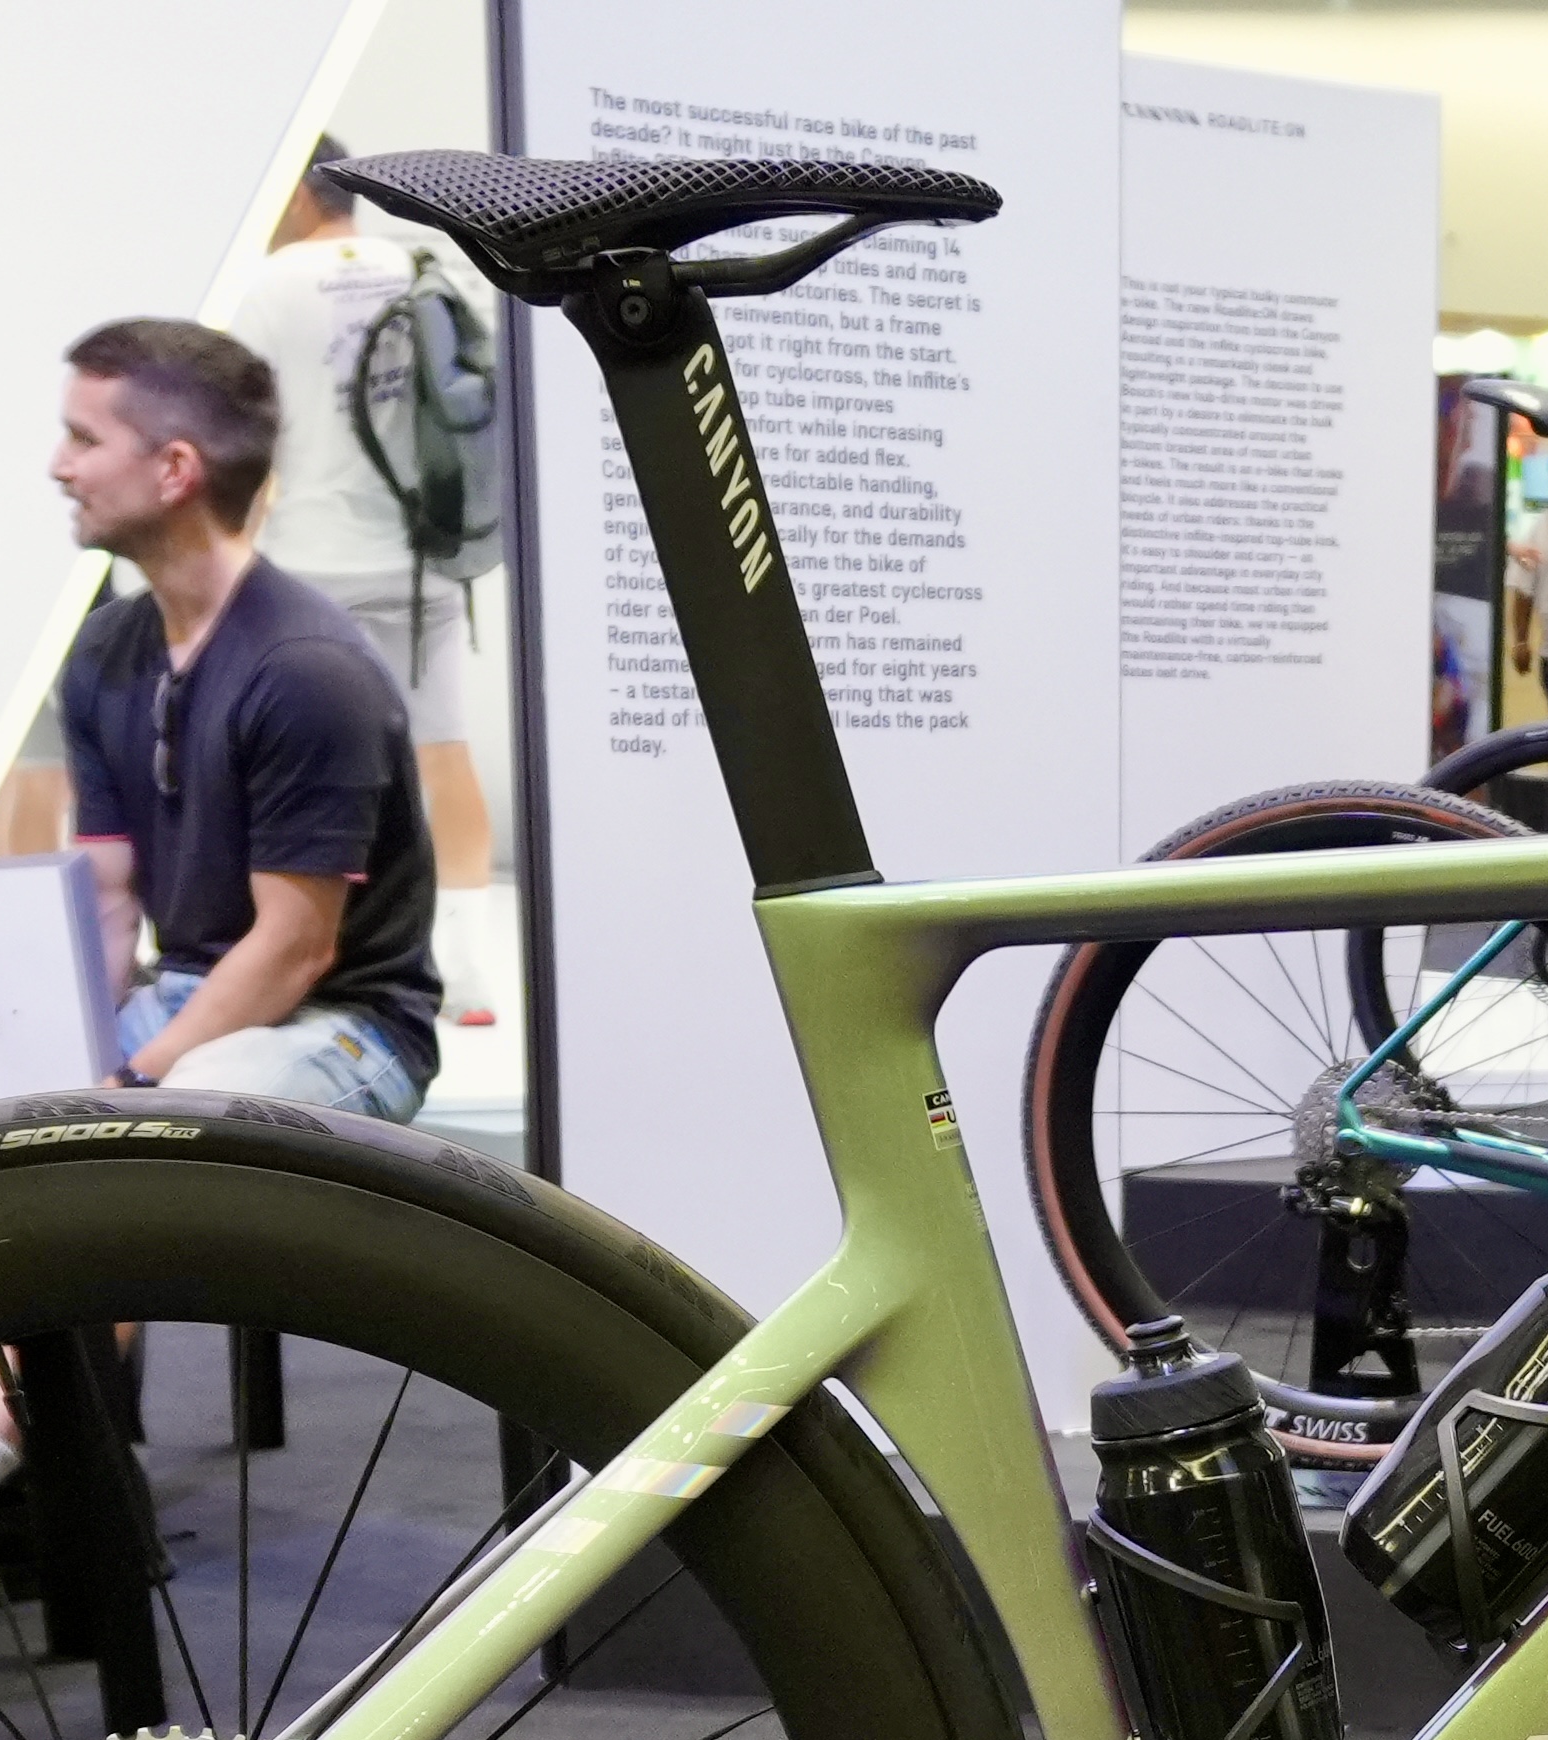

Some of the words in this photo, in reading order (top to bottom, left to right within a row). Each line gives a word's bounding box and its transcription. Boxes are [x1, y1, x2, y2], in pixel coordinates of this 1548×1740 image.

[589, 87, 627, 111] The
[633, 98, 682, 118] most
[688, 105, 788, 130] successful
[795, 118, 835, 135] race
[841, 118, 878, 140] bike
[883, 123, 900, 142] of
[905, 127, 934, 146] the
[939, 133, 977, 152] past
[591, 118, 672, 144] decade?
[678, 128, 691, 147] It
[698, 135, 752, 157] might
[757, 137, 793, 159] just
[863, 237, 937, 260] claiming
[943, 237, 961, 256] 14
[869, 286, 901, 306] The
[907, 294, 962, 310] secret
[966, 291, 982, 313] is
[724, 307, 833, 331] reinvention,
[840, 312, 869, 331] but
[875, 319, 884, 332] a
[889, 315, 941, 336] frame
[683, 343, 773, 594] CANYON
[610, 735, 666, 758] today.
[0, 1121, 133, 1150] 5000
[1263, 1406, 1288, 1428] T
[1290, 1415, 1368, 1442] SWISS
[1478, 1509, 1515, 1546] FUEL
[1512, 1539, 1538, 1560] 600
